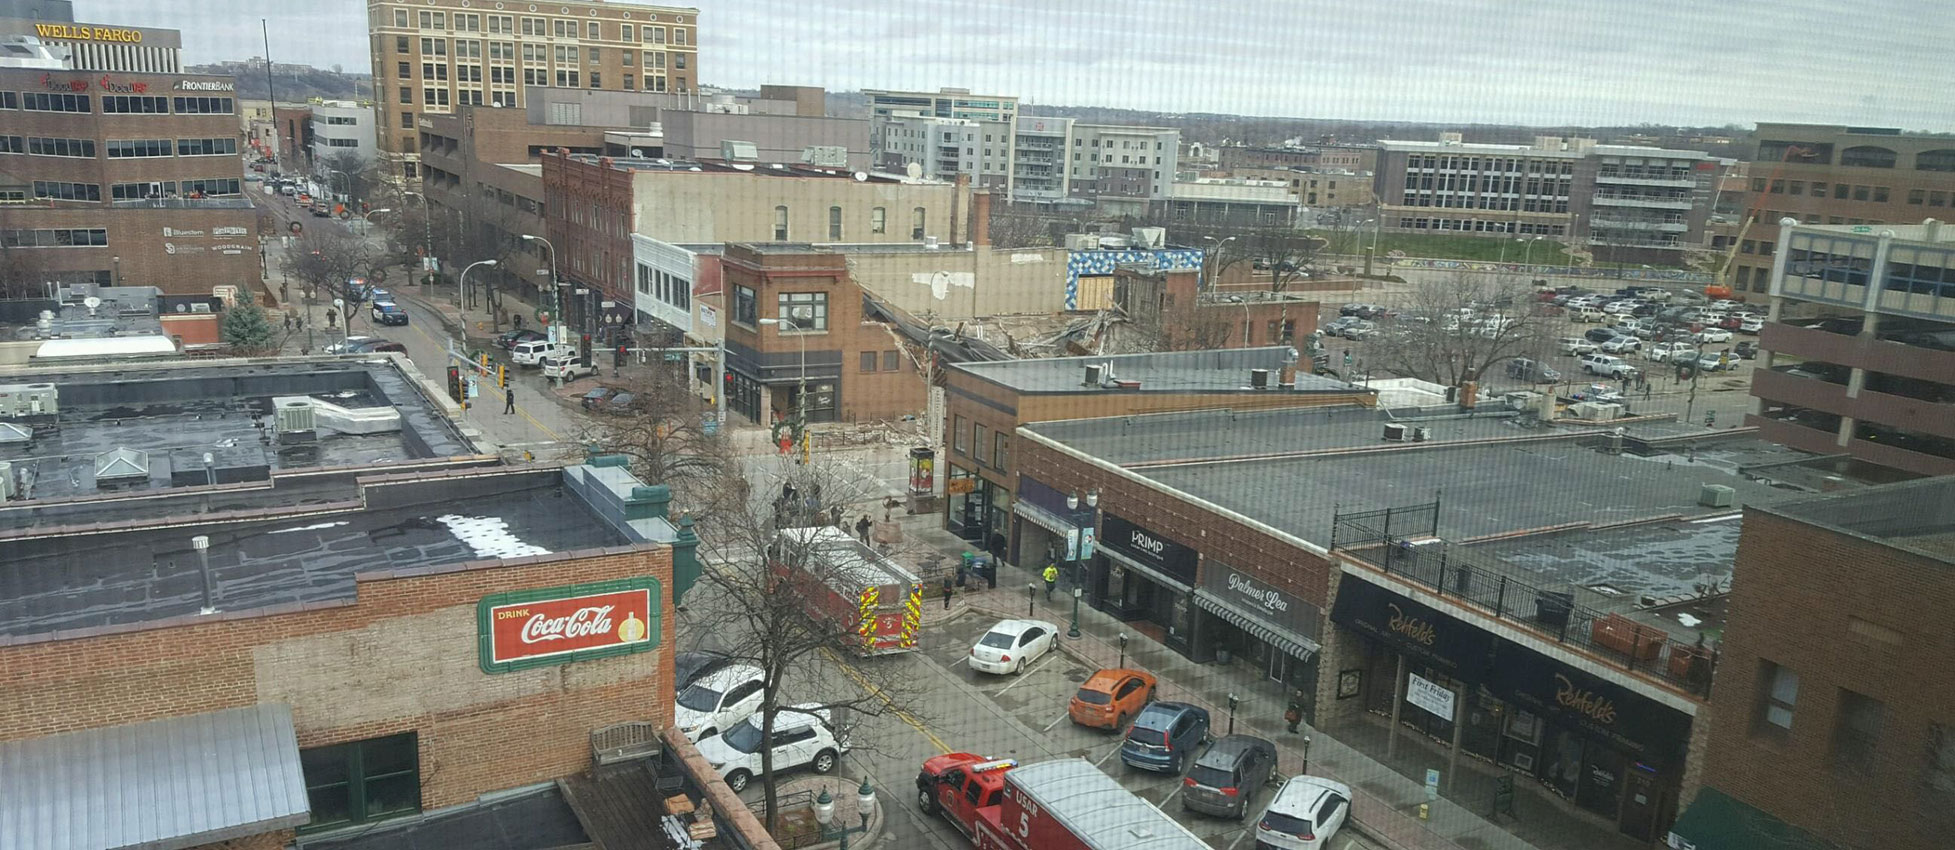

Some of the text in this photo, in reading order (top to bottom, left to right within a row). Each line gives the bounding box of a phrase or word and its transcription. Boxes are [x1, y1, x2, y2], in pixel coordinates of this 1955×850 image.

[36, 23, 142, 43] WELLS FARGO
[1131, 530, 1164, 554] PRIMP
[1228, 573, 1265, 601] Palmer
[1264, 590, 1288, 612] Lea
[498, 608, 530, 620] DRINK
[521, 604, 616, 644] Coca-Cola
[1412, 677, 1428, 690] First
[1429, 685, 1450, 703] Friday
[1015, 790, 1038, 818] USAR
[1018, 811, 1029, 838] 5
